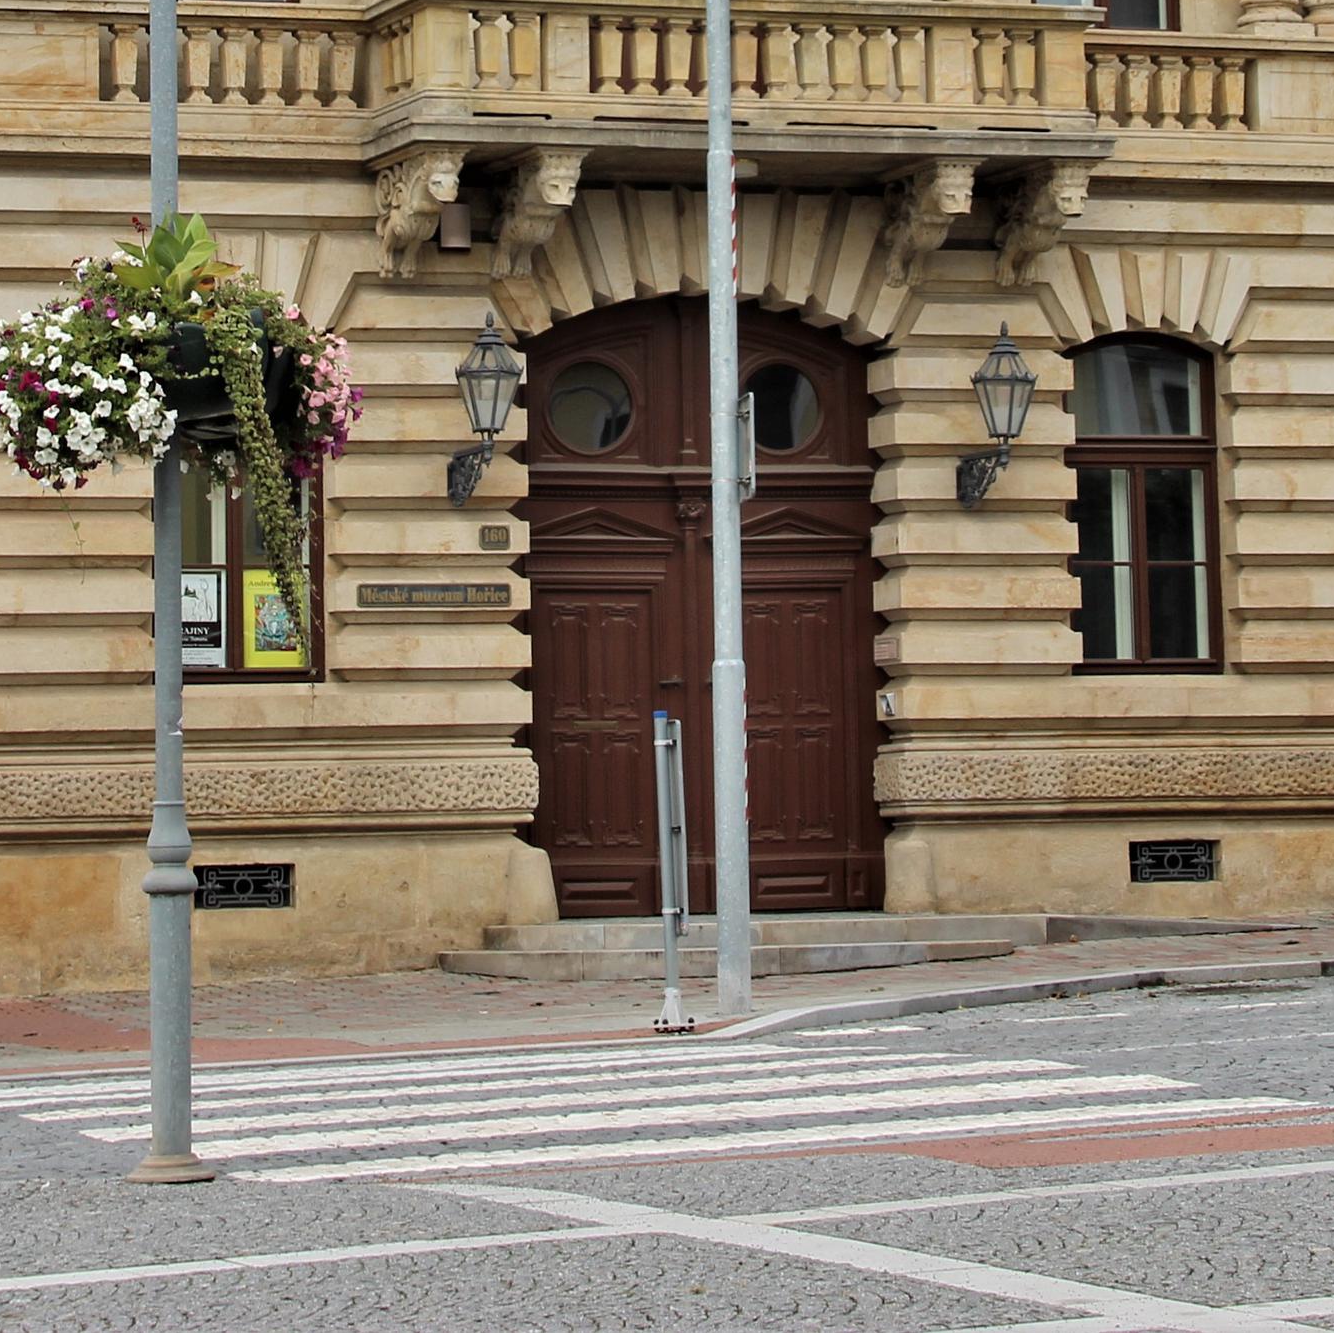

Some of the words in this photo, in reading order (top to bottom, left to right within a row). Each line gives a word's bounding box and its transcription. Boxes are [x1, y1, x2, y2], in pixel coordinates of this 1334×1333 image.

[483, 528, 507, 543] 160
[361, 586, 410, 604] Městské
[411, 589, 463, 604] muzeum
[467, 585, 509, 604] Hořice
